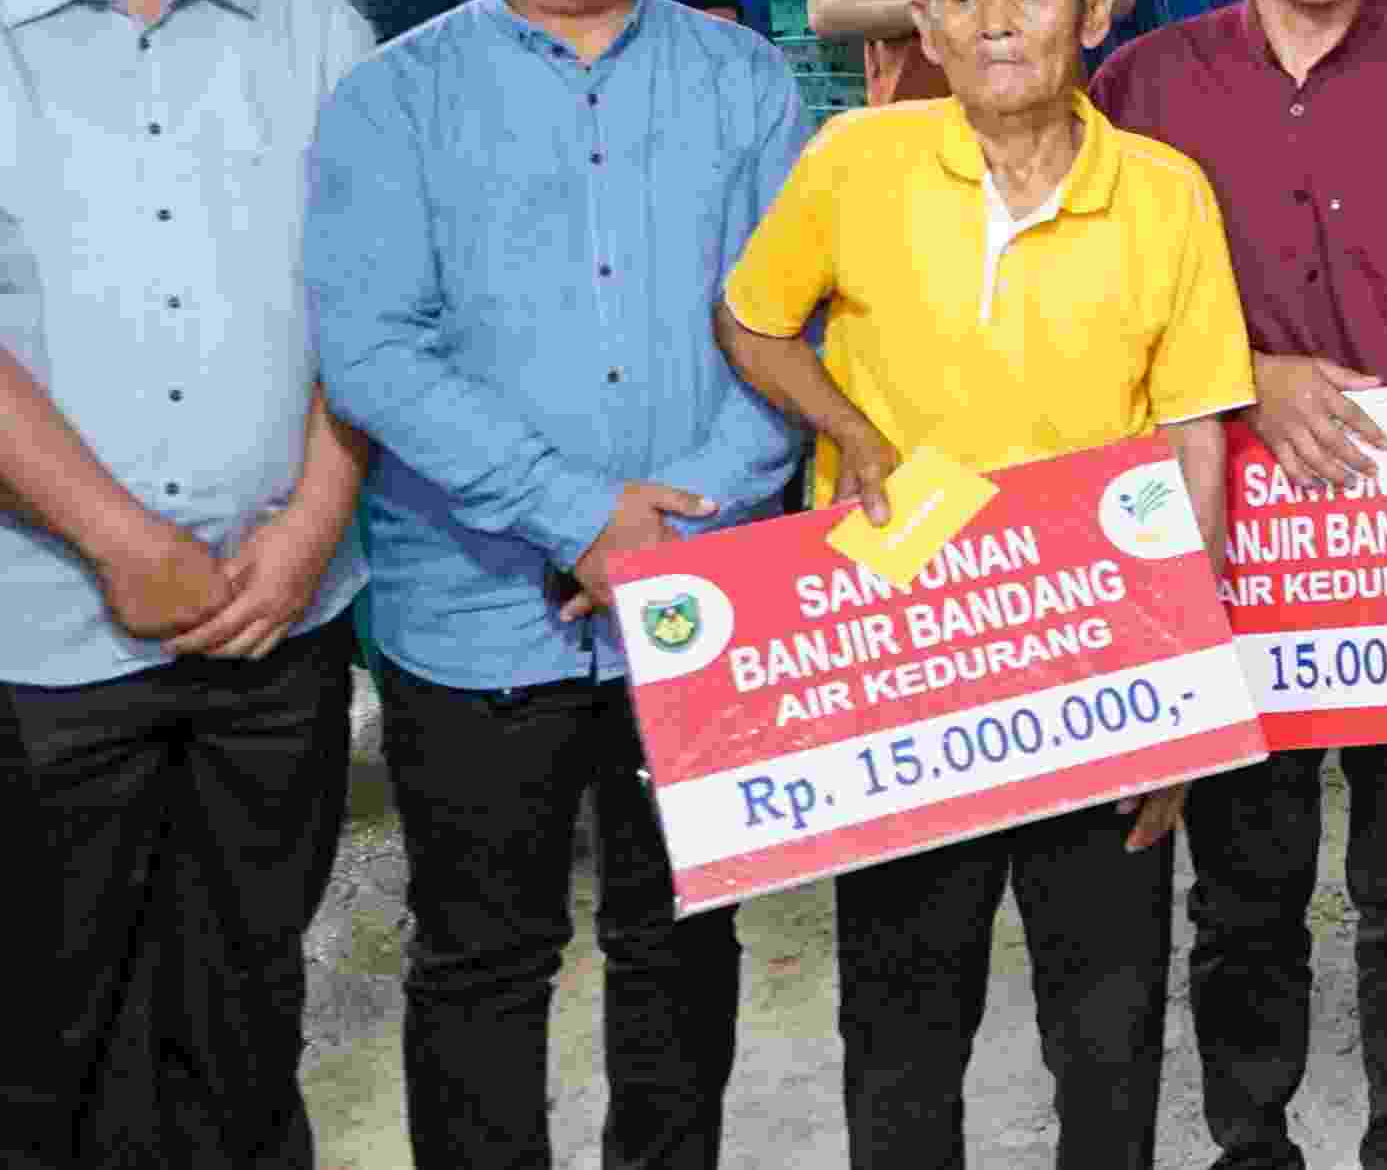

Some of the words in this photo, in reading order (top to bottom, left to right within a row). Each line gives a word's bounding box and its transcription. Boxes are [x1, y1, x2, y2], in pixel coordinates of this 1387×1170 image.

[796, 525, 1041, 618] SANUNAN
[1216, 574, 1276, 607] AIR
[729, 613, 900, 692] BANJIR
[905, 560, 1126, 649] BANDANG
[775, 679, 852, 726] AIR
[863, 618, 1113, 704] KEDURANG
[738, 773, 836, 830] Rp.
[856, 678, 1197, 797] 15.000.000,-
